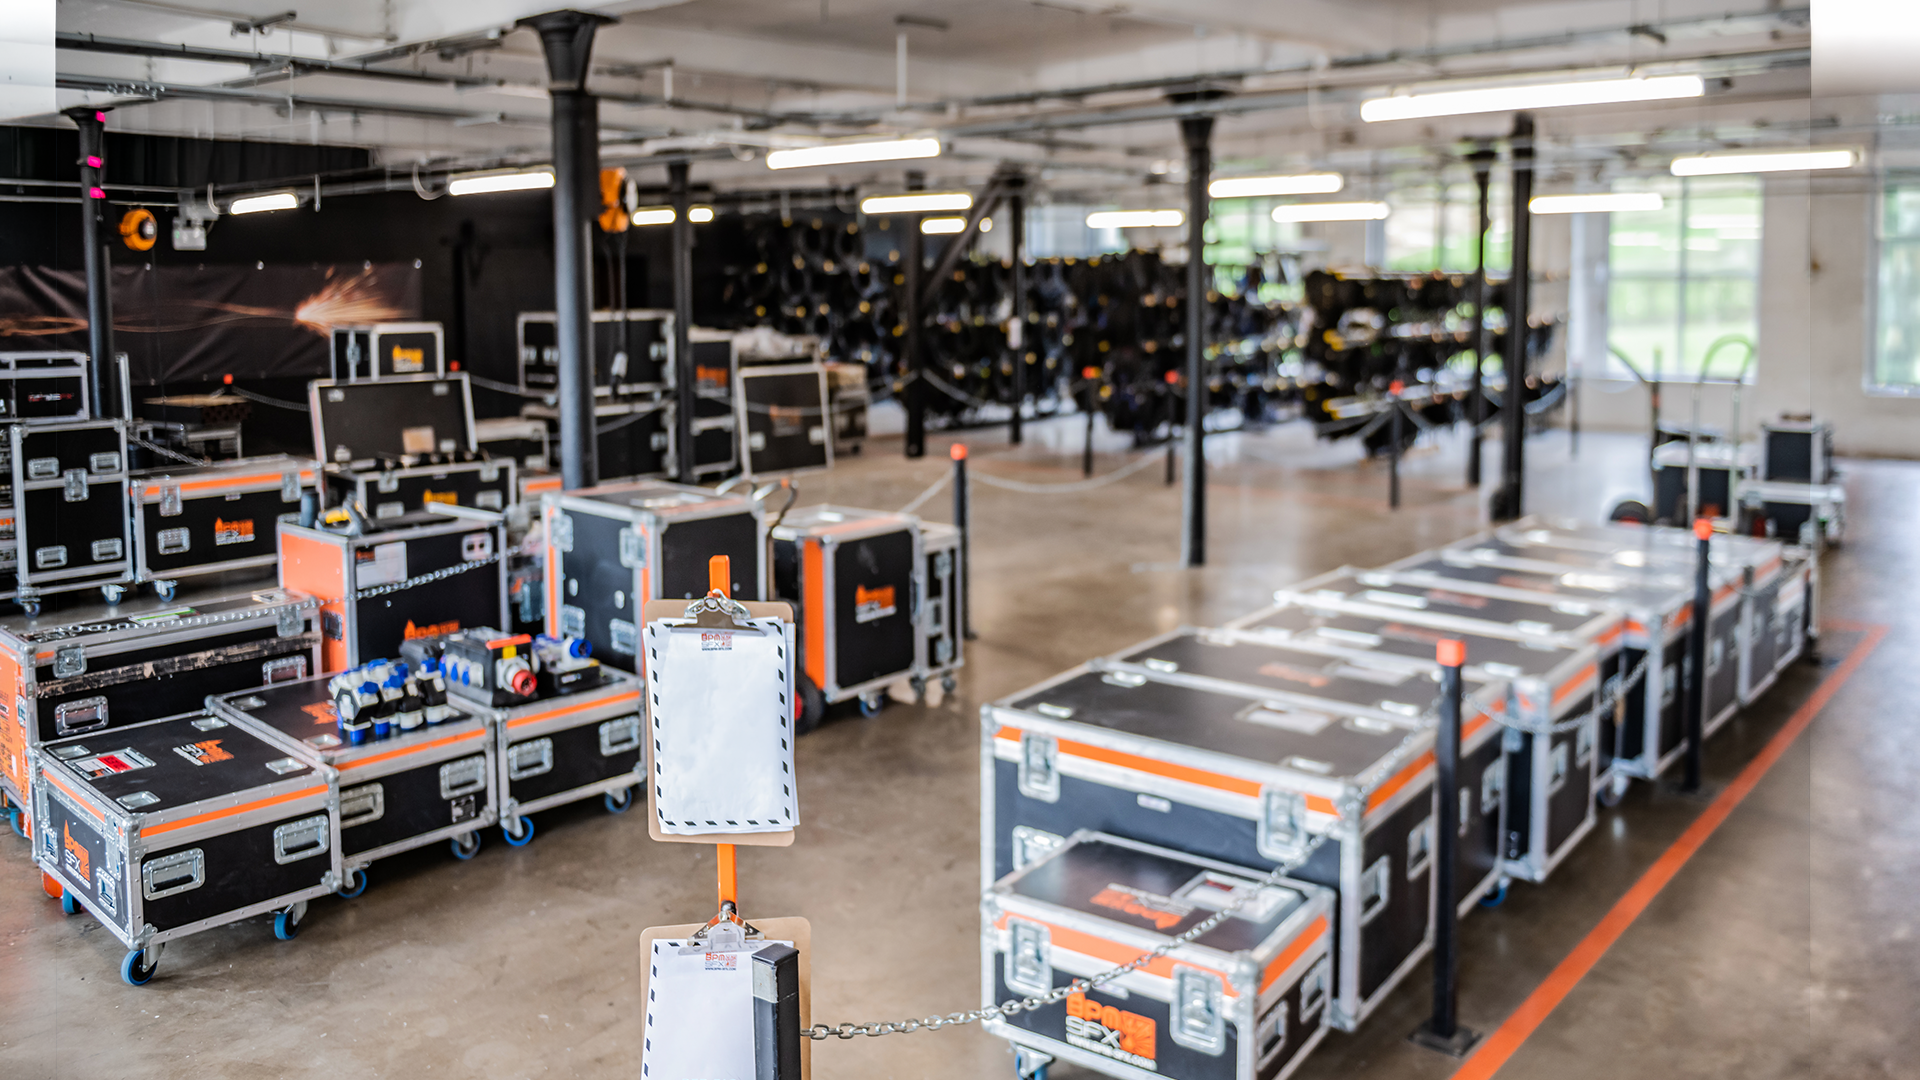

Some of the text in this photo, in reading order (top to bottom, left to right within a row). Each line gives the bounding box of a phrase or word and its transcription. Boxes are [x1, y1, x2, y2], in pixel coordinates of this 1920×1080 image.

[64, 848, 81, 873] SFX
[705, 952, 725, 961] BPM
[1066, 981, 1122, 1031] BPM
[1065, 1015, 1121, 1049] SFX
